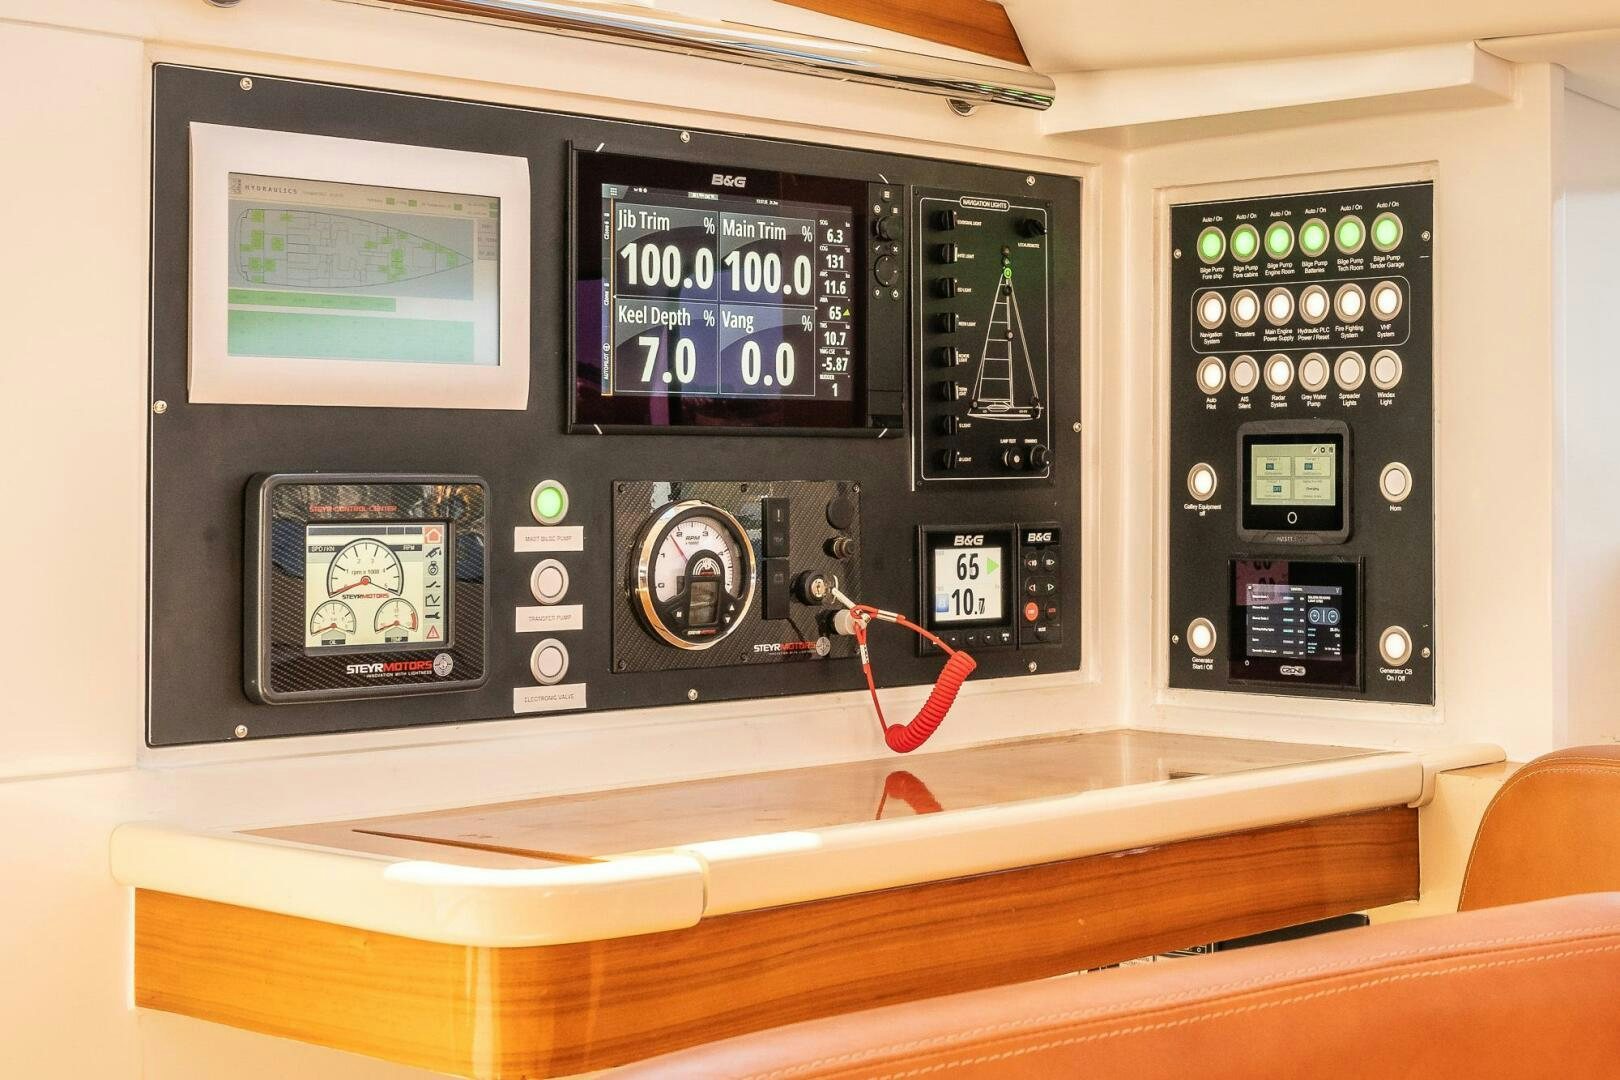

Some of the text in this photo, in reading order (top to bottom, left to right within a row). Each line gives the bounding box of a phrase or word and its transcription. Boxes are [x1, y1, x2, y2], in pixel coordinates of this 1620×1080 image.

[711, 174, 746, 188] B&G
[244, 185, 297, 194] HYDRAULICS
[962, 199, 1007, 209] NAVIGATION LIGHTS
[617, 209, 636, 231] Jib
[639, 211, 670, 231] Trim
[703, 216, 716, 234] %
[722, 218, 813, 242] Main Trim %
[826, 228, 844, 244] 6.3
[620, 242, 714, 290] 100.0
[826, 254, 844, 269] 131
[724, 250, 812, 296] 100.0
[824, 280, 847, 294] 11.6
[618, 305, 715, 330] Keel Depth %
[829, 306, 842, 320] 65
[722, 310, 813, 334] Vang %
[824, 331, 846, 346] 10.7
[638, 336, 696, 384] 7.0
[741, 340, 795, 386] 0.0
[822, 356, 848, 371] -5.87
[832, 382, 838, 397] 1
[954, 535, 984, 546] B&G
[1028, 532, 1052, 542] B&G
[957, 553, 980, 580] 65
[952, 588, 986, 616] 10.7
